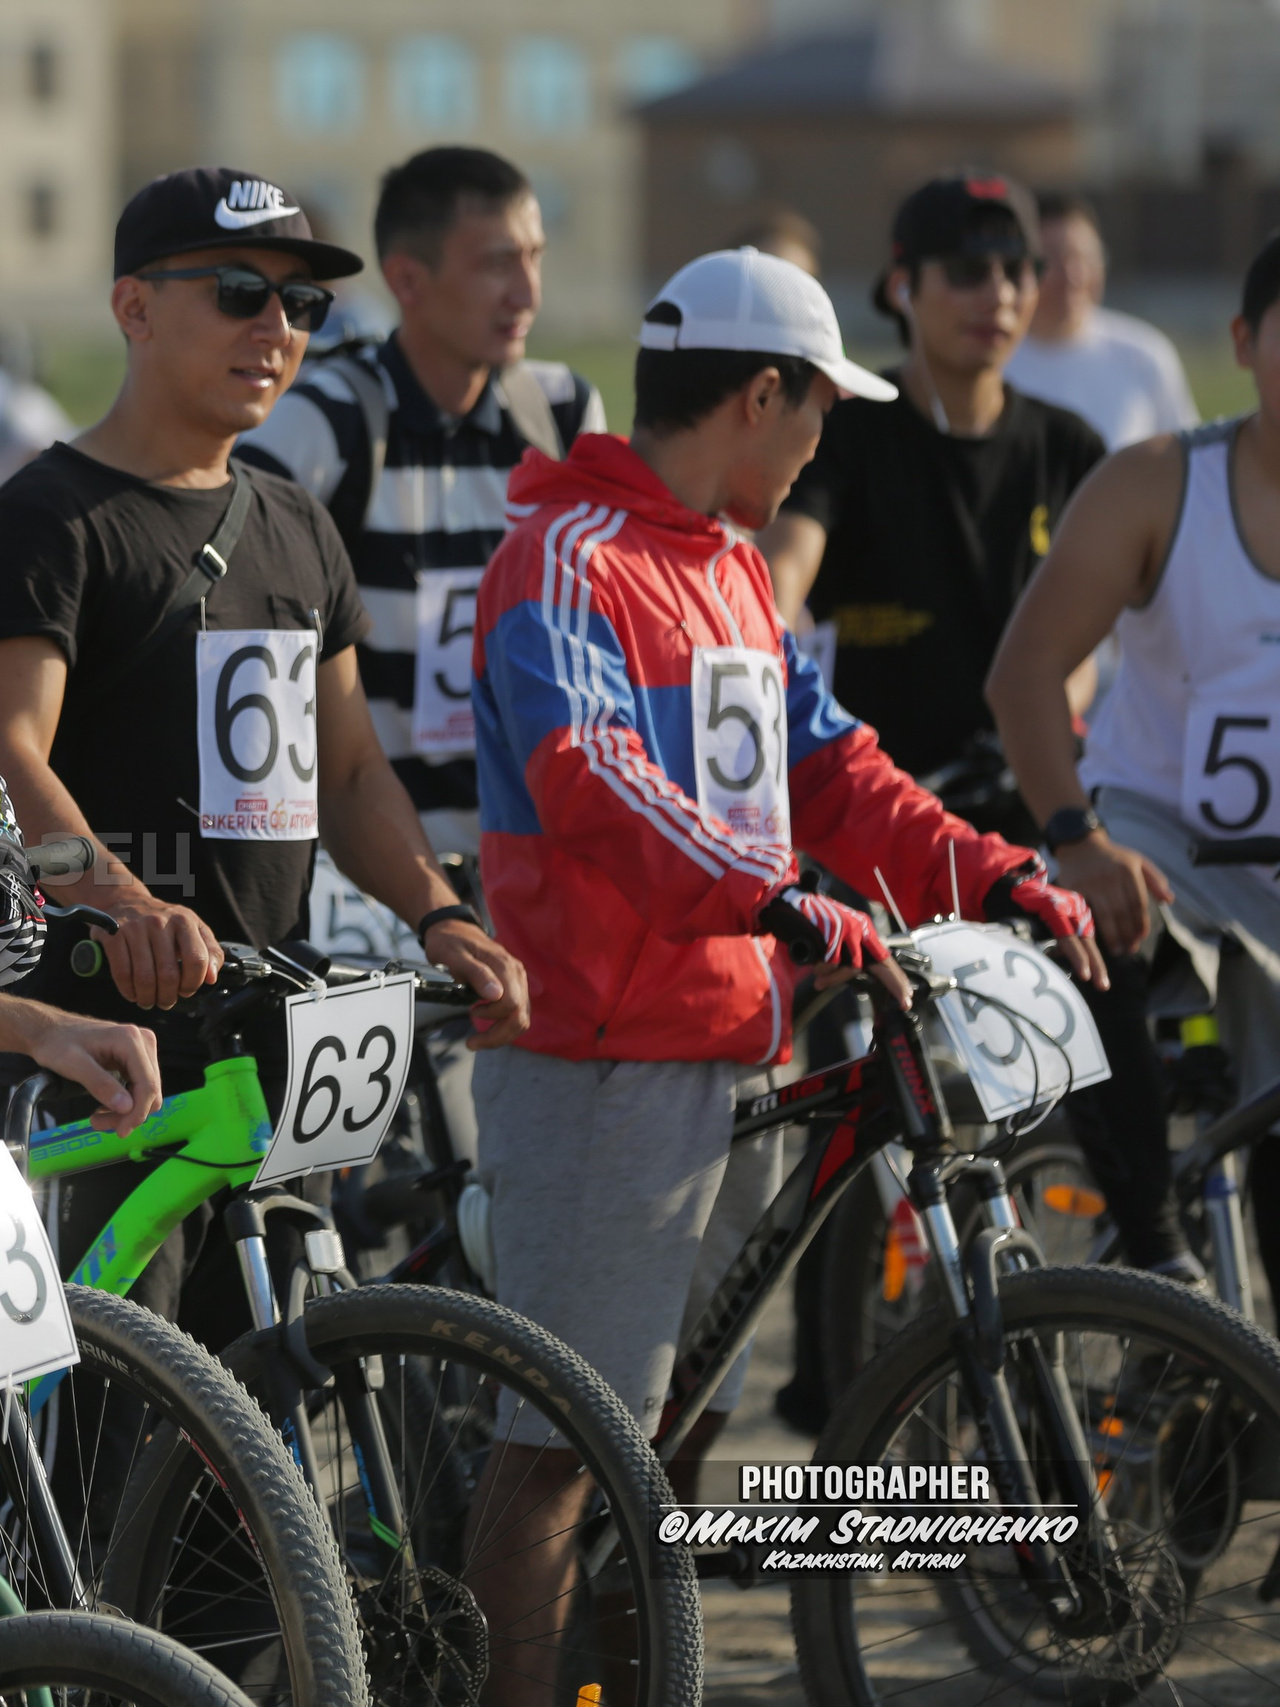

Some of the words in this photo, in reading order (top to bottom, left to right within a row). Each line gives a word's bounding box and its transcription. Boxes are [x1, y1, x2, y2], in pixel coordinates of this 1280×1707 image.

[228, 180, 285, 210] NIKE
[215, 645, 317, 784] 63
[954, 951, 1075, 1066] 53
[293, 1025, 396, 1144] 63
[431, 1319, 572, 1415] KENDA
